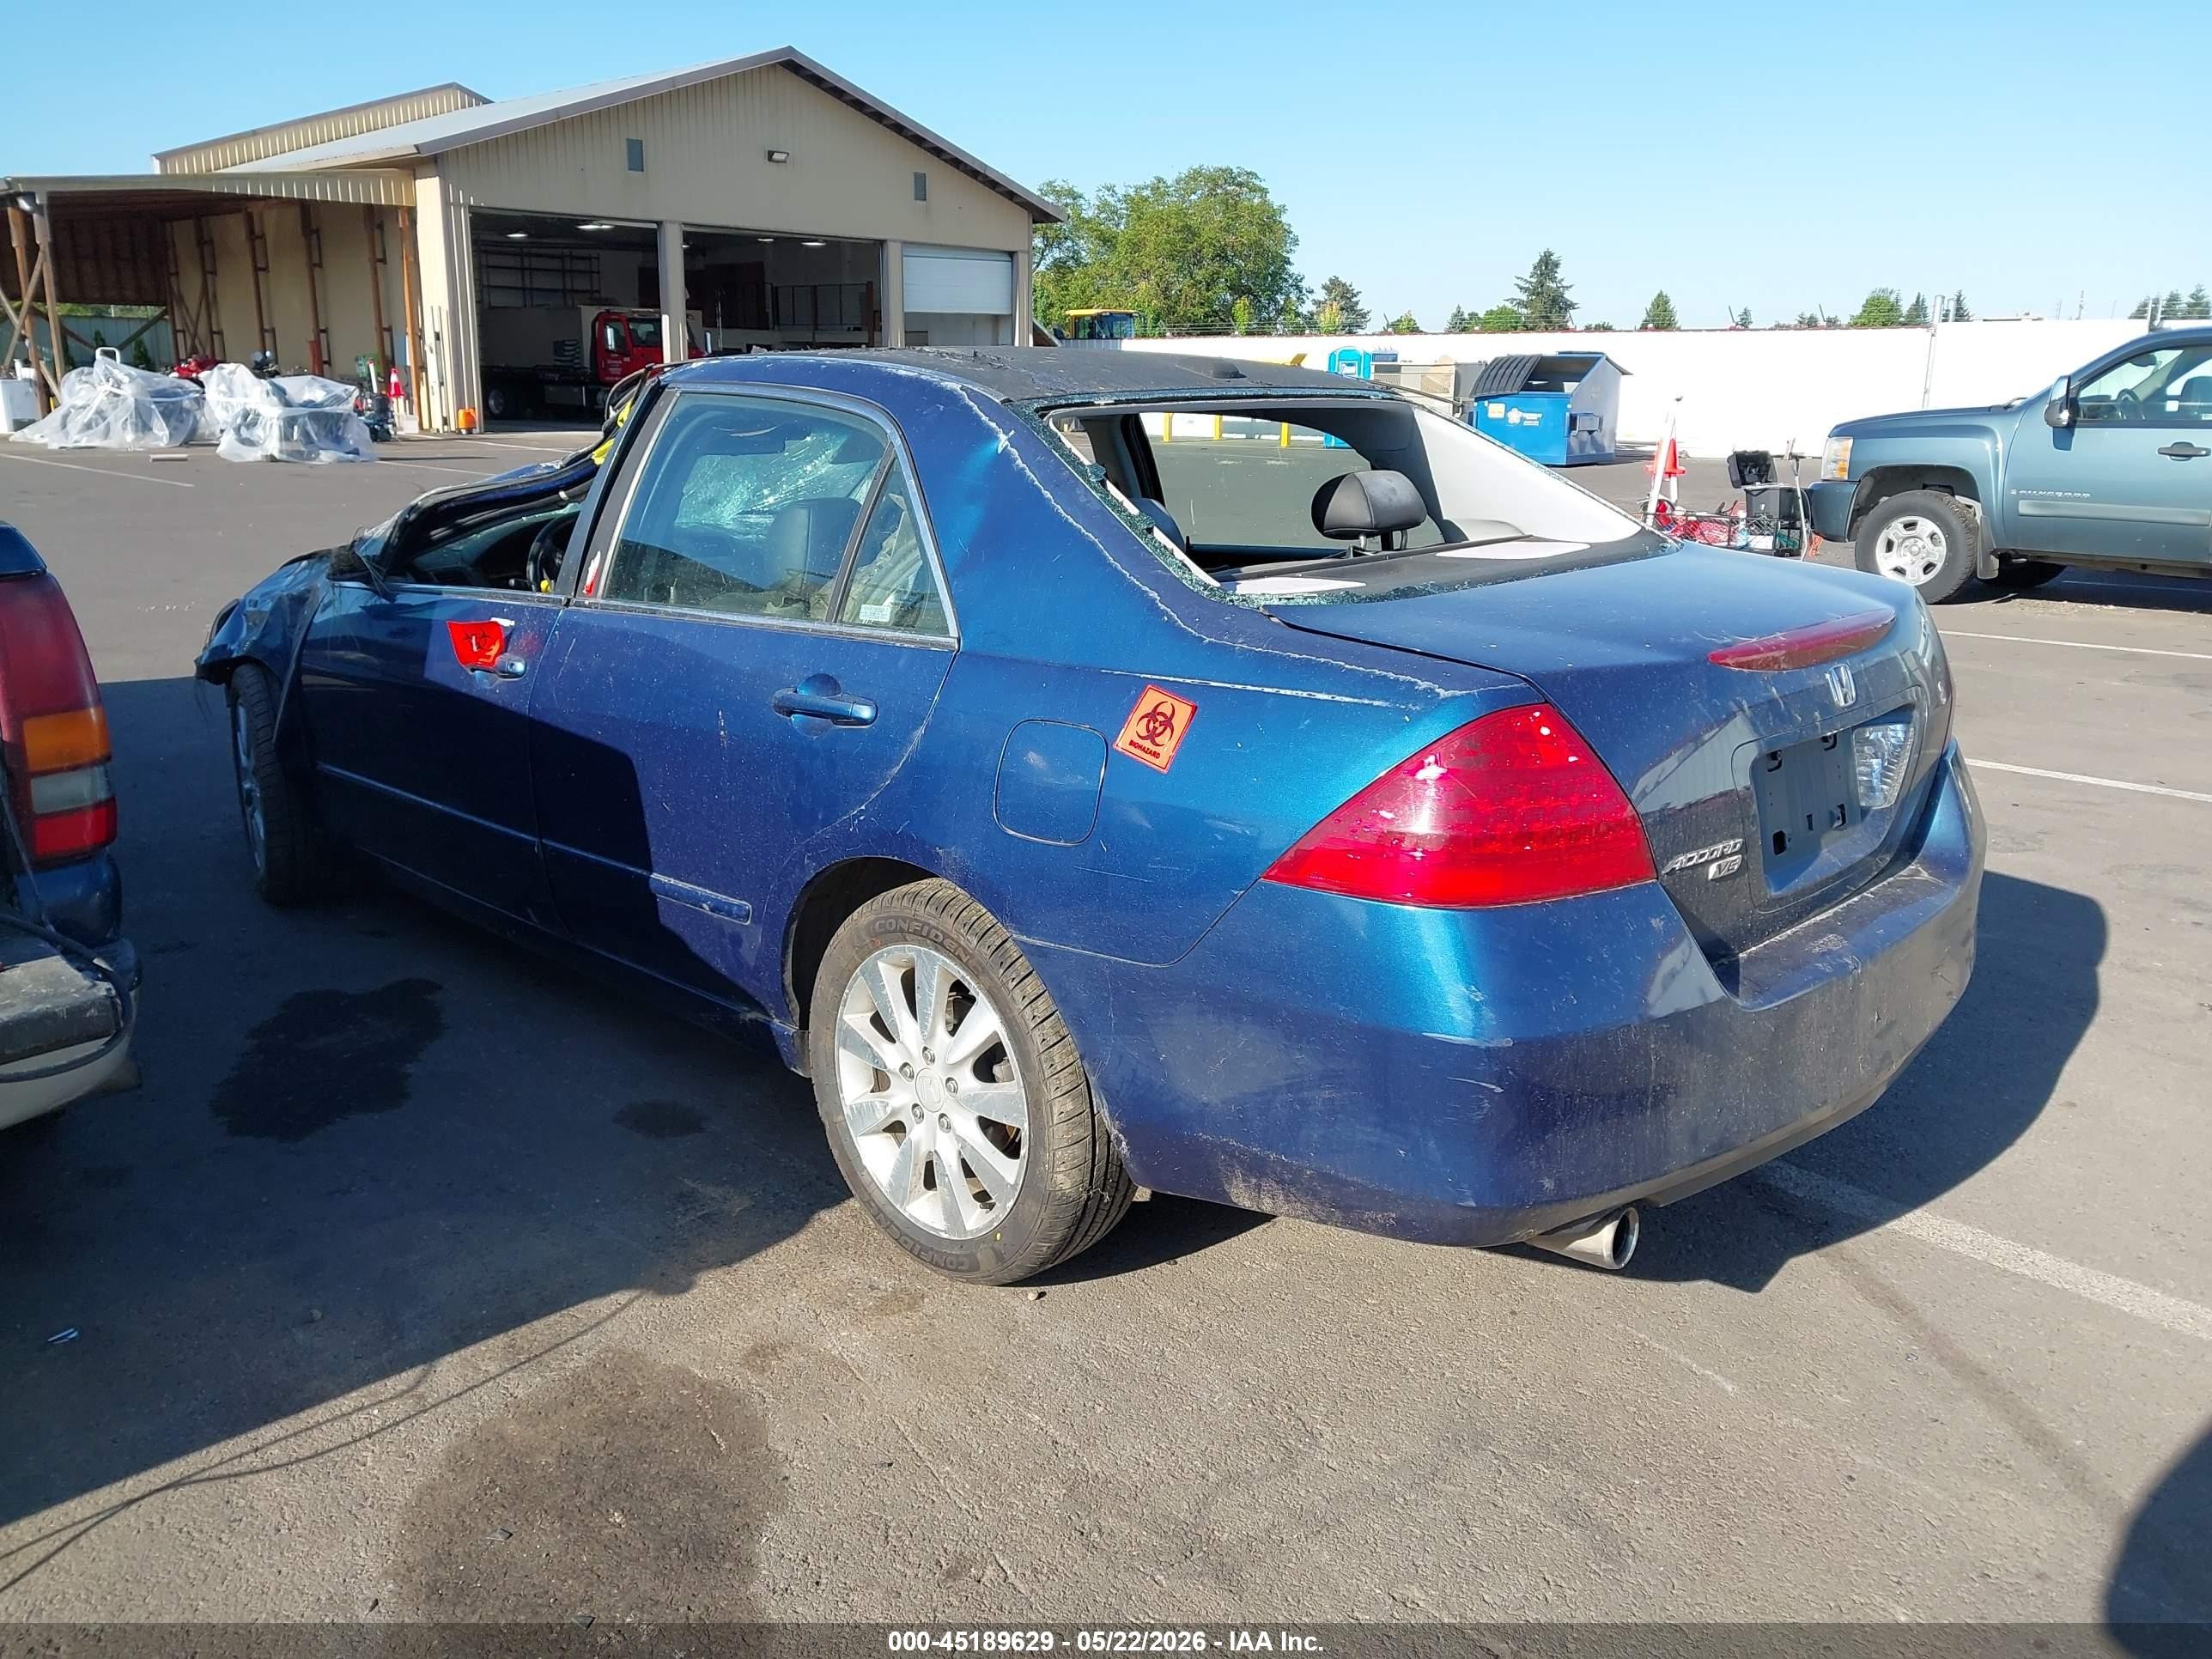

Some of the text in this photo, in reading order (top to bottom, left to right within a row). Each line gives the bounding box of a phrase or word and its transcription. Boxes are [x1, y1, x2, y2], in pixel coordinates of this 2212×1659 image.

[1128, 739, 1161, 759] BIOHAZARD
[1661, 839, 1743, 876] ACCORD
[1712, 855, 1742, 878] V6
